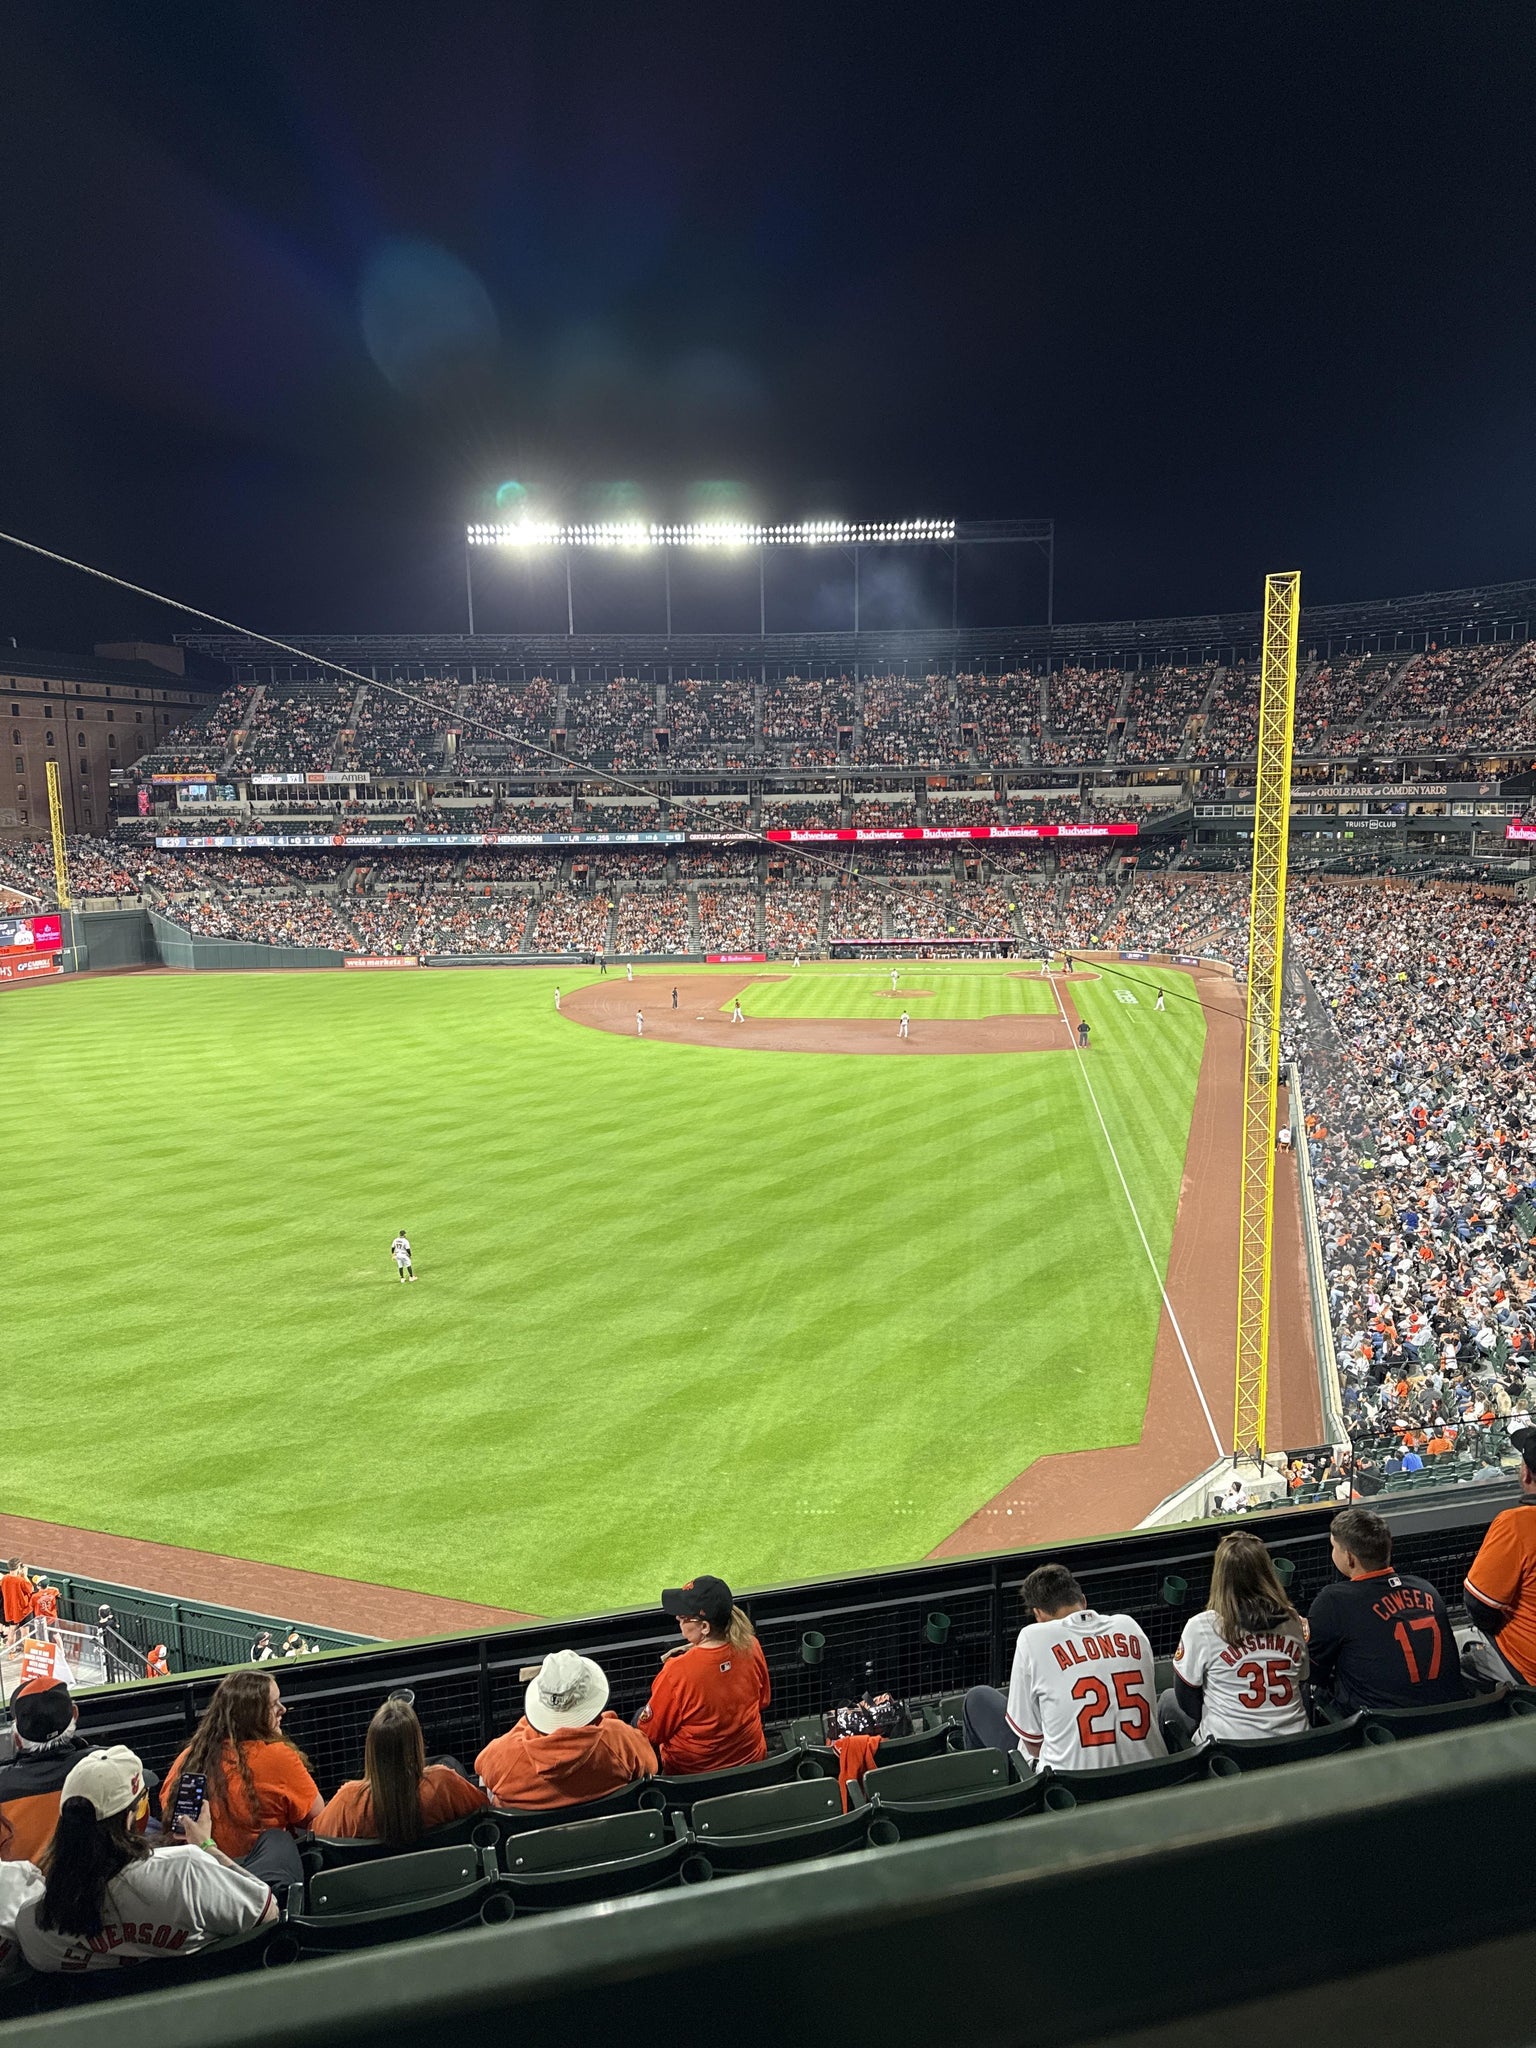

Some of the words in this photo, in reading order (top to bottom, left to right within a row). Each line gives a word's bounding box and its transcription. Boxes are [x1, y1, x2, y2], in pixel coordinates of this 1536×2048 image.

[1317, 788, 1350, 797] ORIOLE
[1350, 787, 1374, 796] PARK
[1382, 786, 1421, 796] CAMDEN
[1421, 785, 1448, 795] YARDS
[1378, 820, 1397, 828] CLUB
[790, 831, 838, 840] Budweiser
[856, 830, 904, 839] Budweiser
[922, 829, 971, 838] Budweiser
[990, 828, 1038, 836] Budweiser
[1058, 827, 1109, 836] Budweiser
[256, 837, 272, 845] BAL
[277, 837, 284, 845] 4
[497, 835, 543, 843] HENDERSON
[1372, 1589, 1435, 1621] COWSER
[1051, 1633, 1142, 1671] ALONSO
[1393, 1616, 1442, 1684] 17
[1237, 1660, 1294, 1709] 35
[1071, 1669, 1151, 1748] 25
